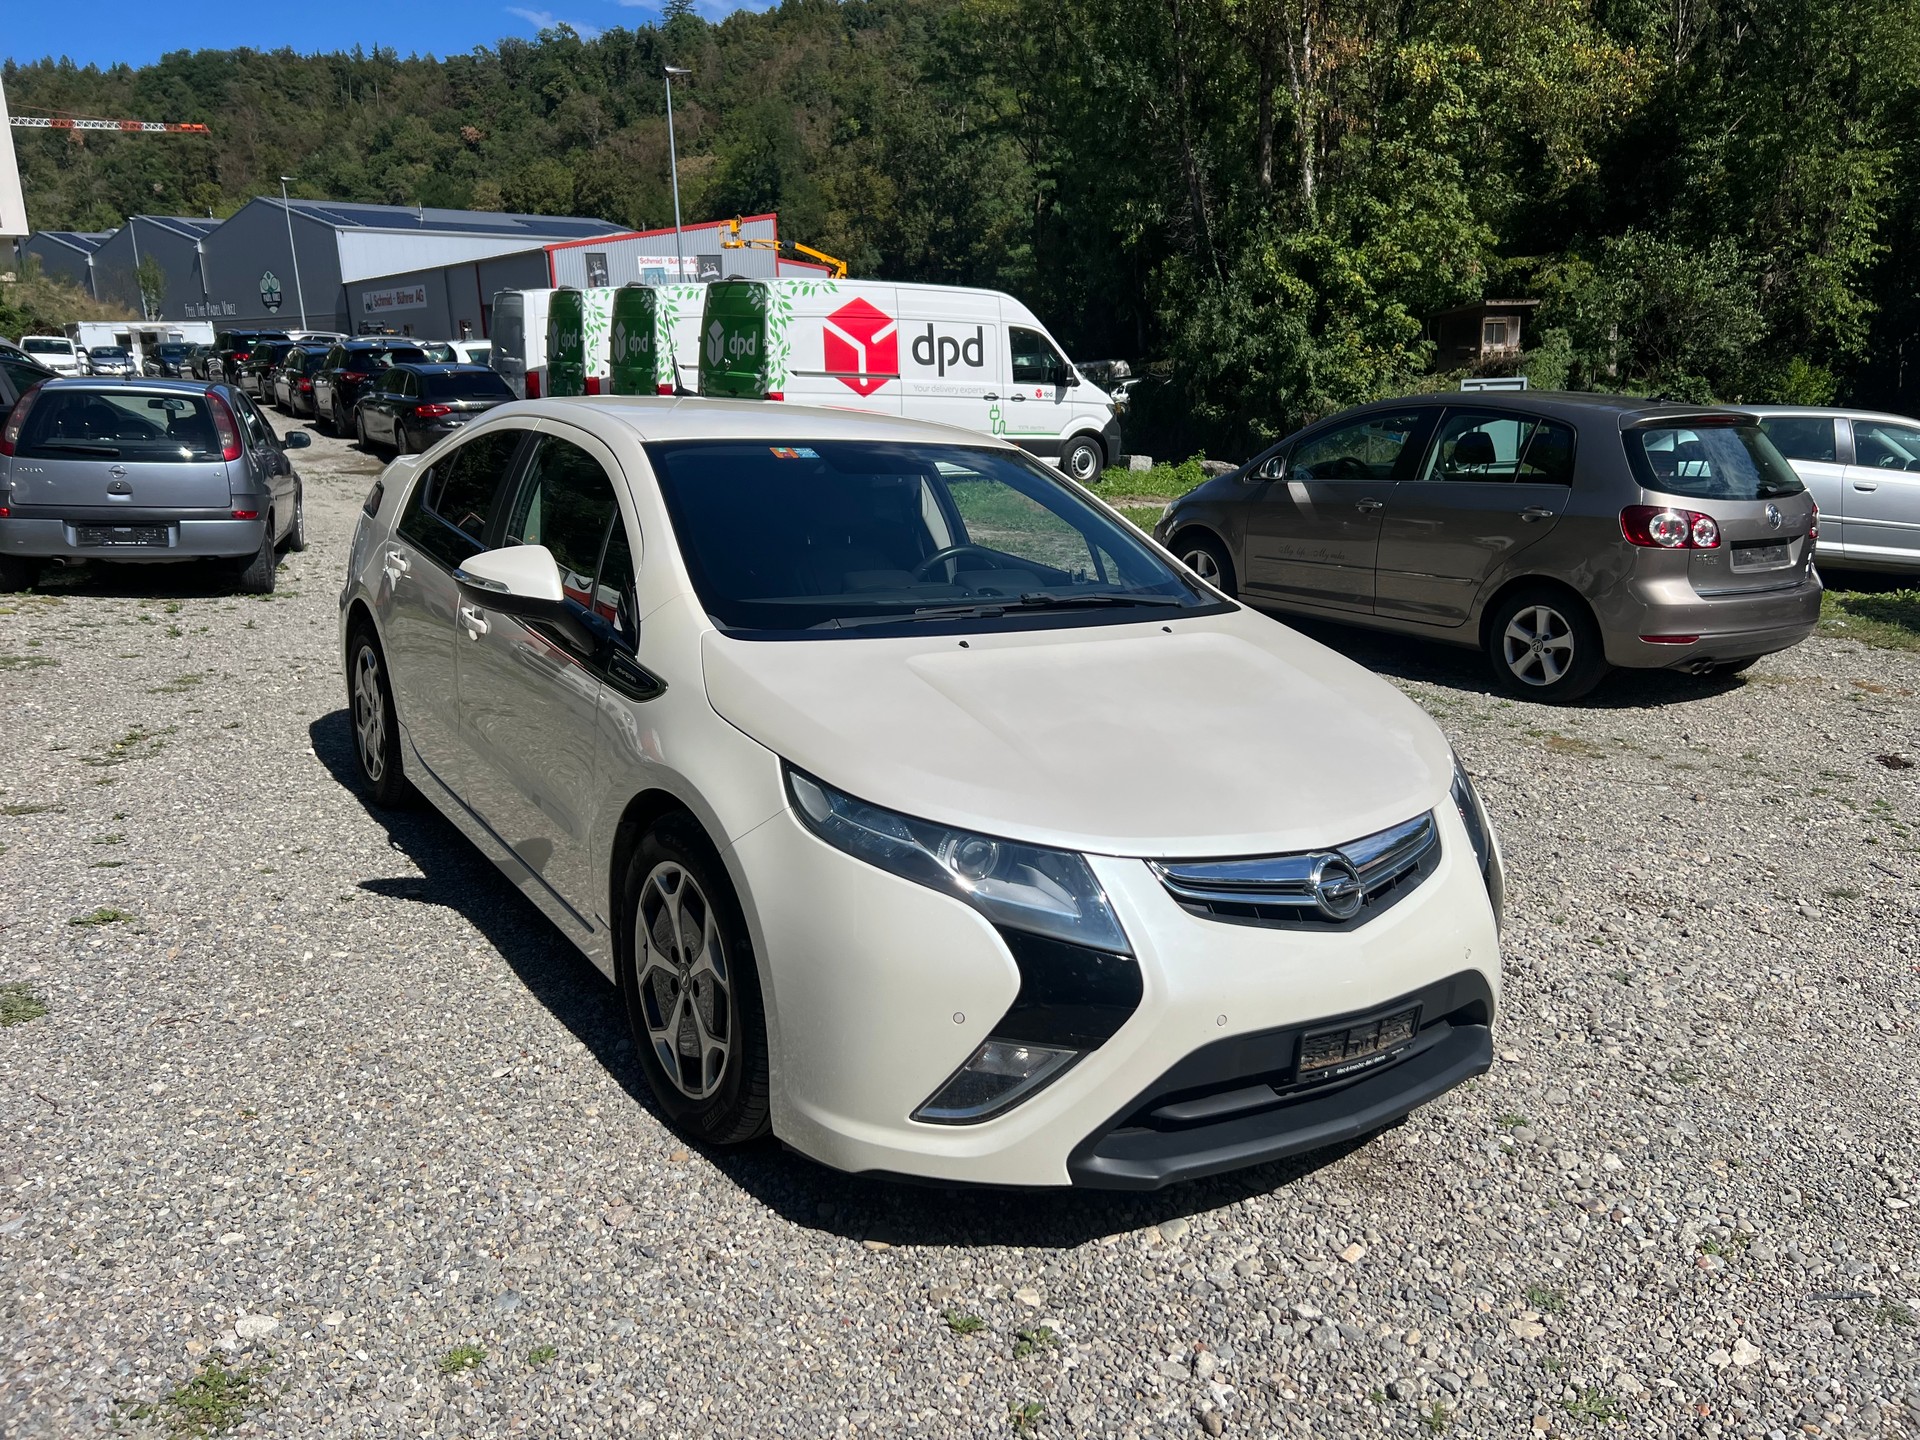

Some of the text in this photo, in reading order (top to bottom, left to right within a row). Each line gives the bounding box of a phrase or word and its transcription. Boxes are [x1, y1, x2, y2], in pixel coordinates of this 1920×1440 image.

[640, 257, 662, 265] Schmid
[703, 263, 717, 273] 35
[373, 292, 393, 307] Schmid
[415, 288, 424, 303] AG
[561, 328, 577, 352] dpd
[629, 330, 648, 357] dpd
[729, 330, 756, 360] dpd
[912, 323, 984, 377] dpd
[913, 384, 930, 392] Your
[931, 385, 958, 395] delivery
